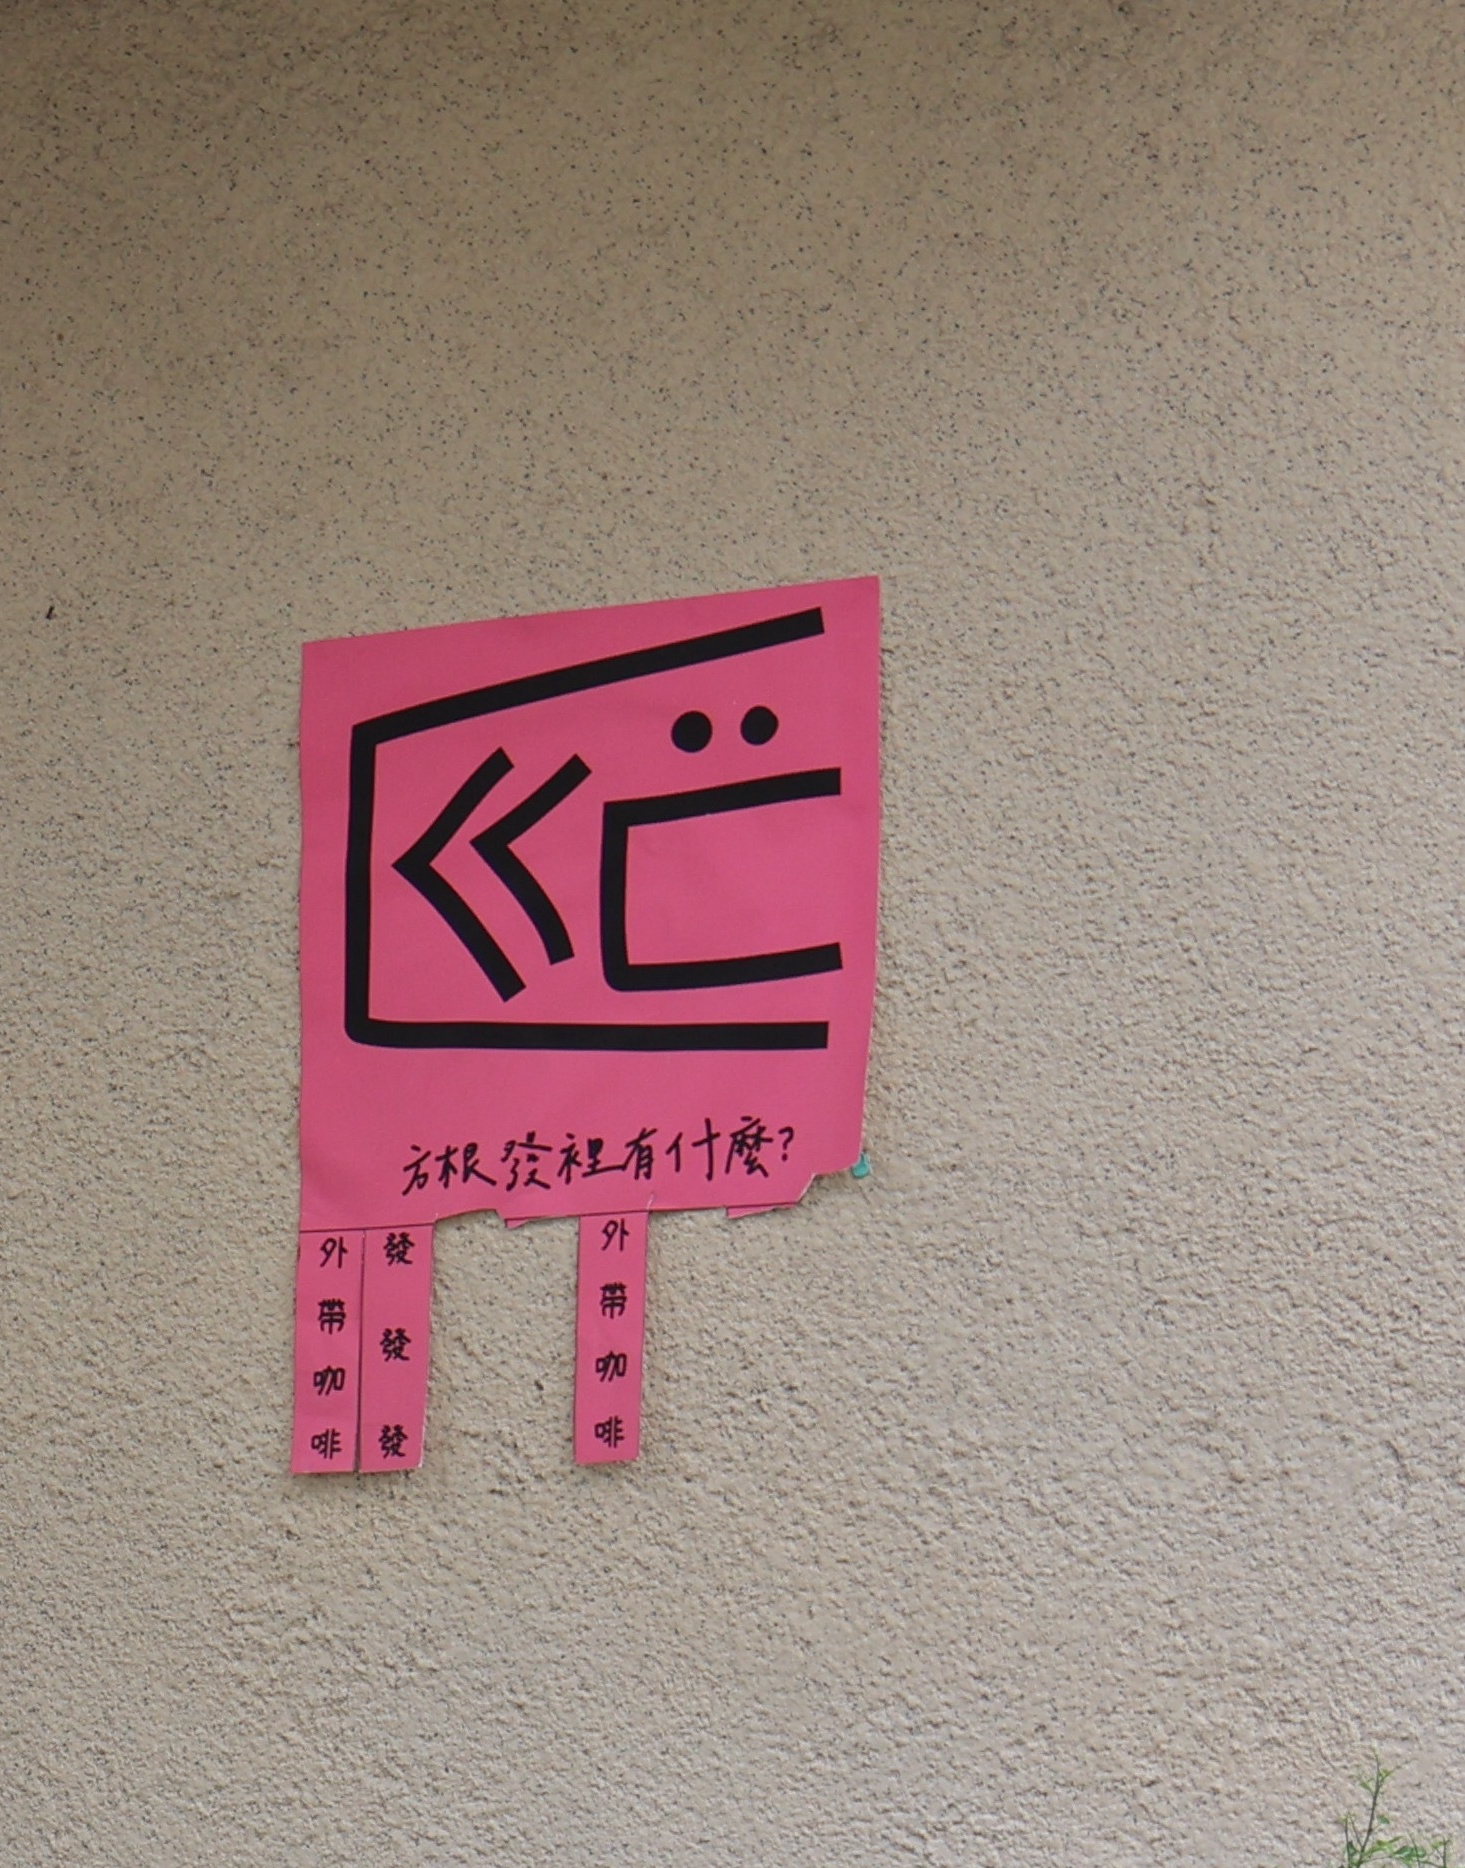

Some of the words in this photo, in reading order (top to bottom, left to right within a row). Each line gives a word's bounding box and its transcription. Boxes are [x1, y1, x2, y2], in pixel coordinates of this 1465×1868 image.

[310, 1236, 348, 1460] 外帶咖啡
[378, 1232, 414, 1459] 發發發
[594, 1218, 629, 1449] 外帶咖啡
